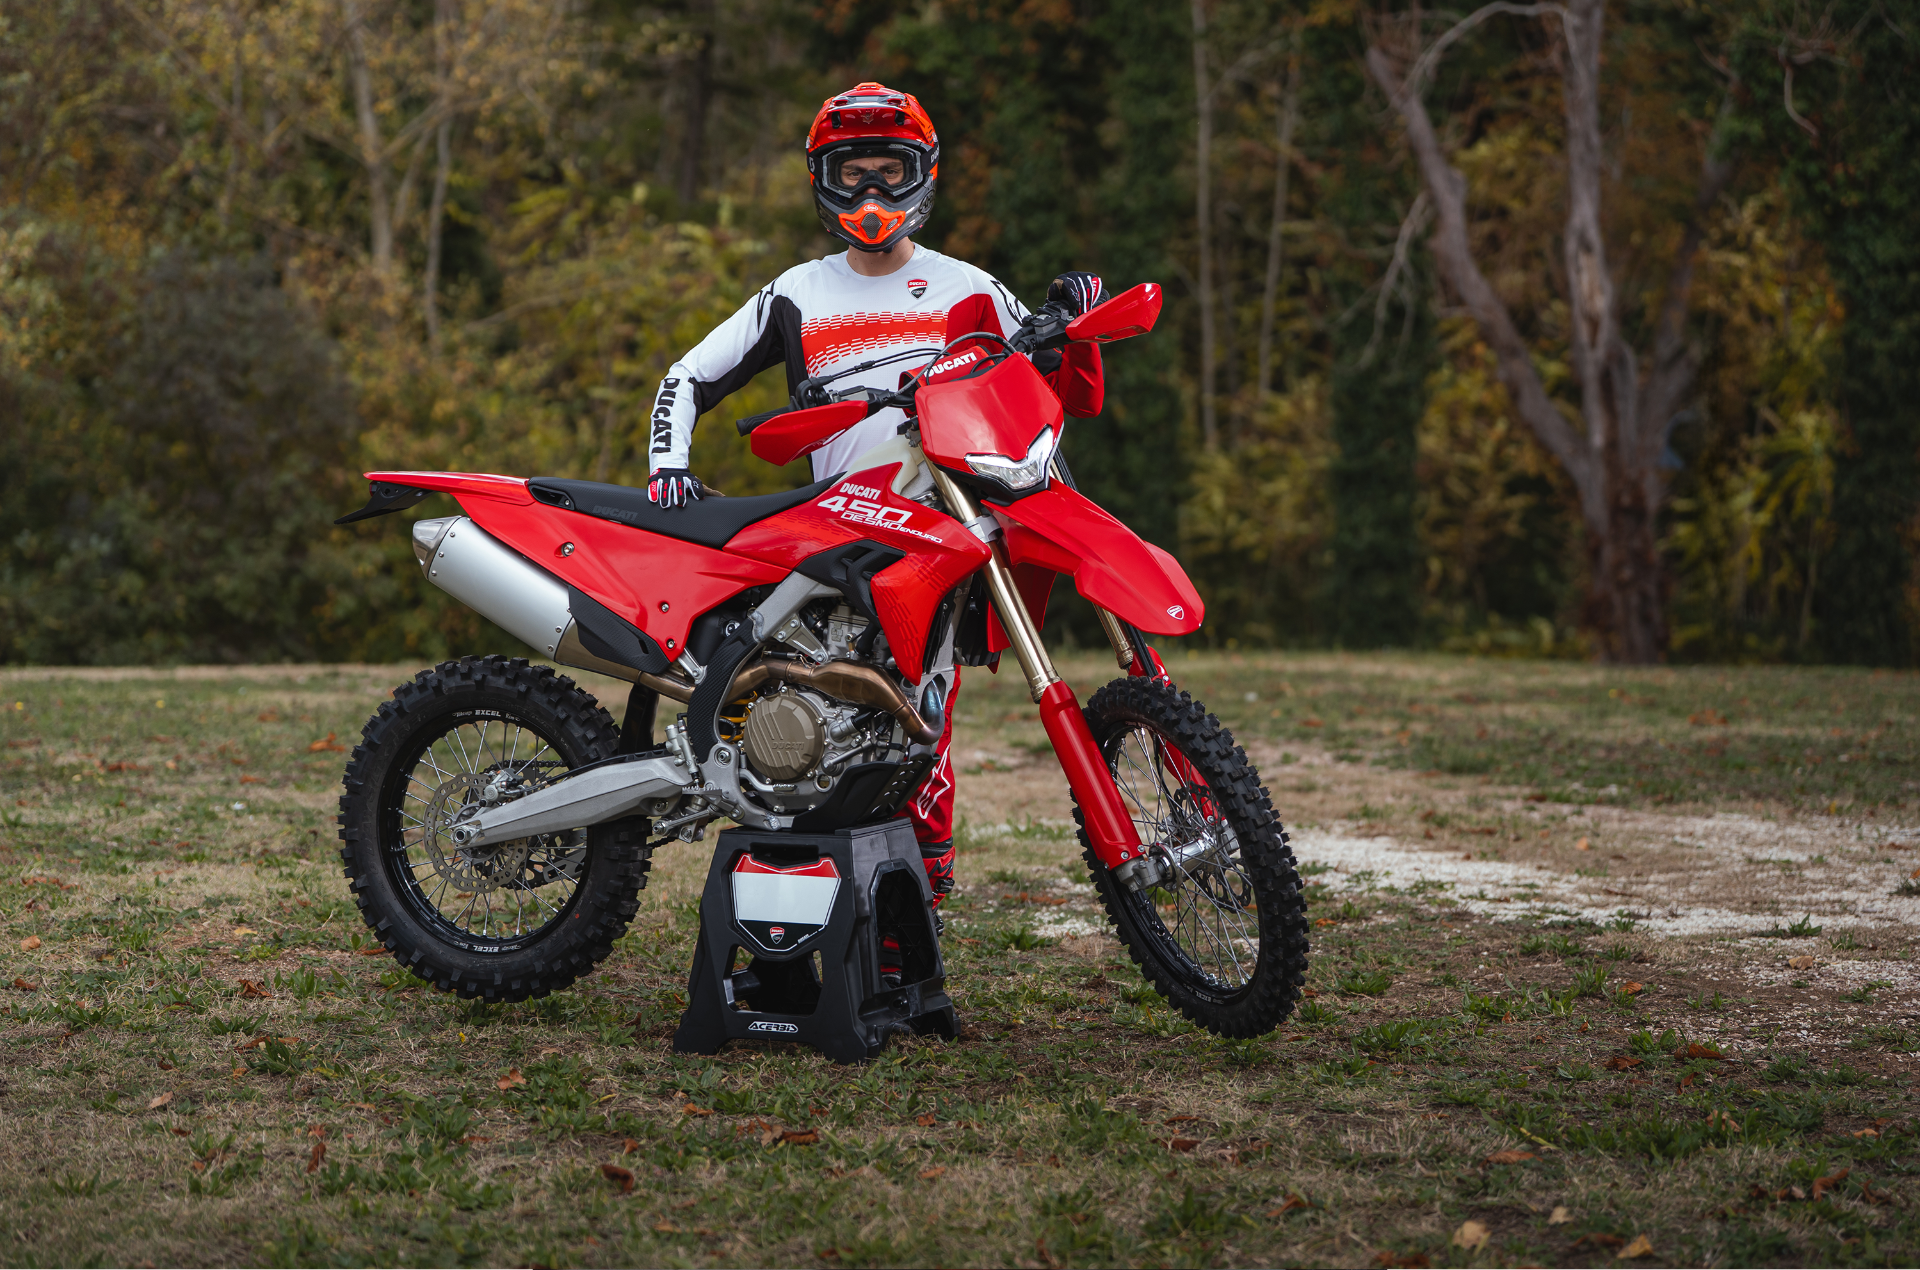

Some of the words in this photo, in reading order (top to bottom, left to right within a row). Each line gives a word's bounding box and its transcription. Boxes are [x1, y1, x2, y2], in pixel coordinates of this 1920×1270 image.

[923, 352, 977, 378] DUCATI
[652, 378, 680, 454] DUCATI
[839, 482, 881, 500] DUCATI
[592, 505, 638, 520] DUCATI
[817, 495, 913, 525] 450
[474, 709, 501, 717] EXCEL
[771, 741, 805, 751] DUCATI
[473, 945, 500, 953] EXCEL
[749, 1022, 798, 1033] ACERBIS
